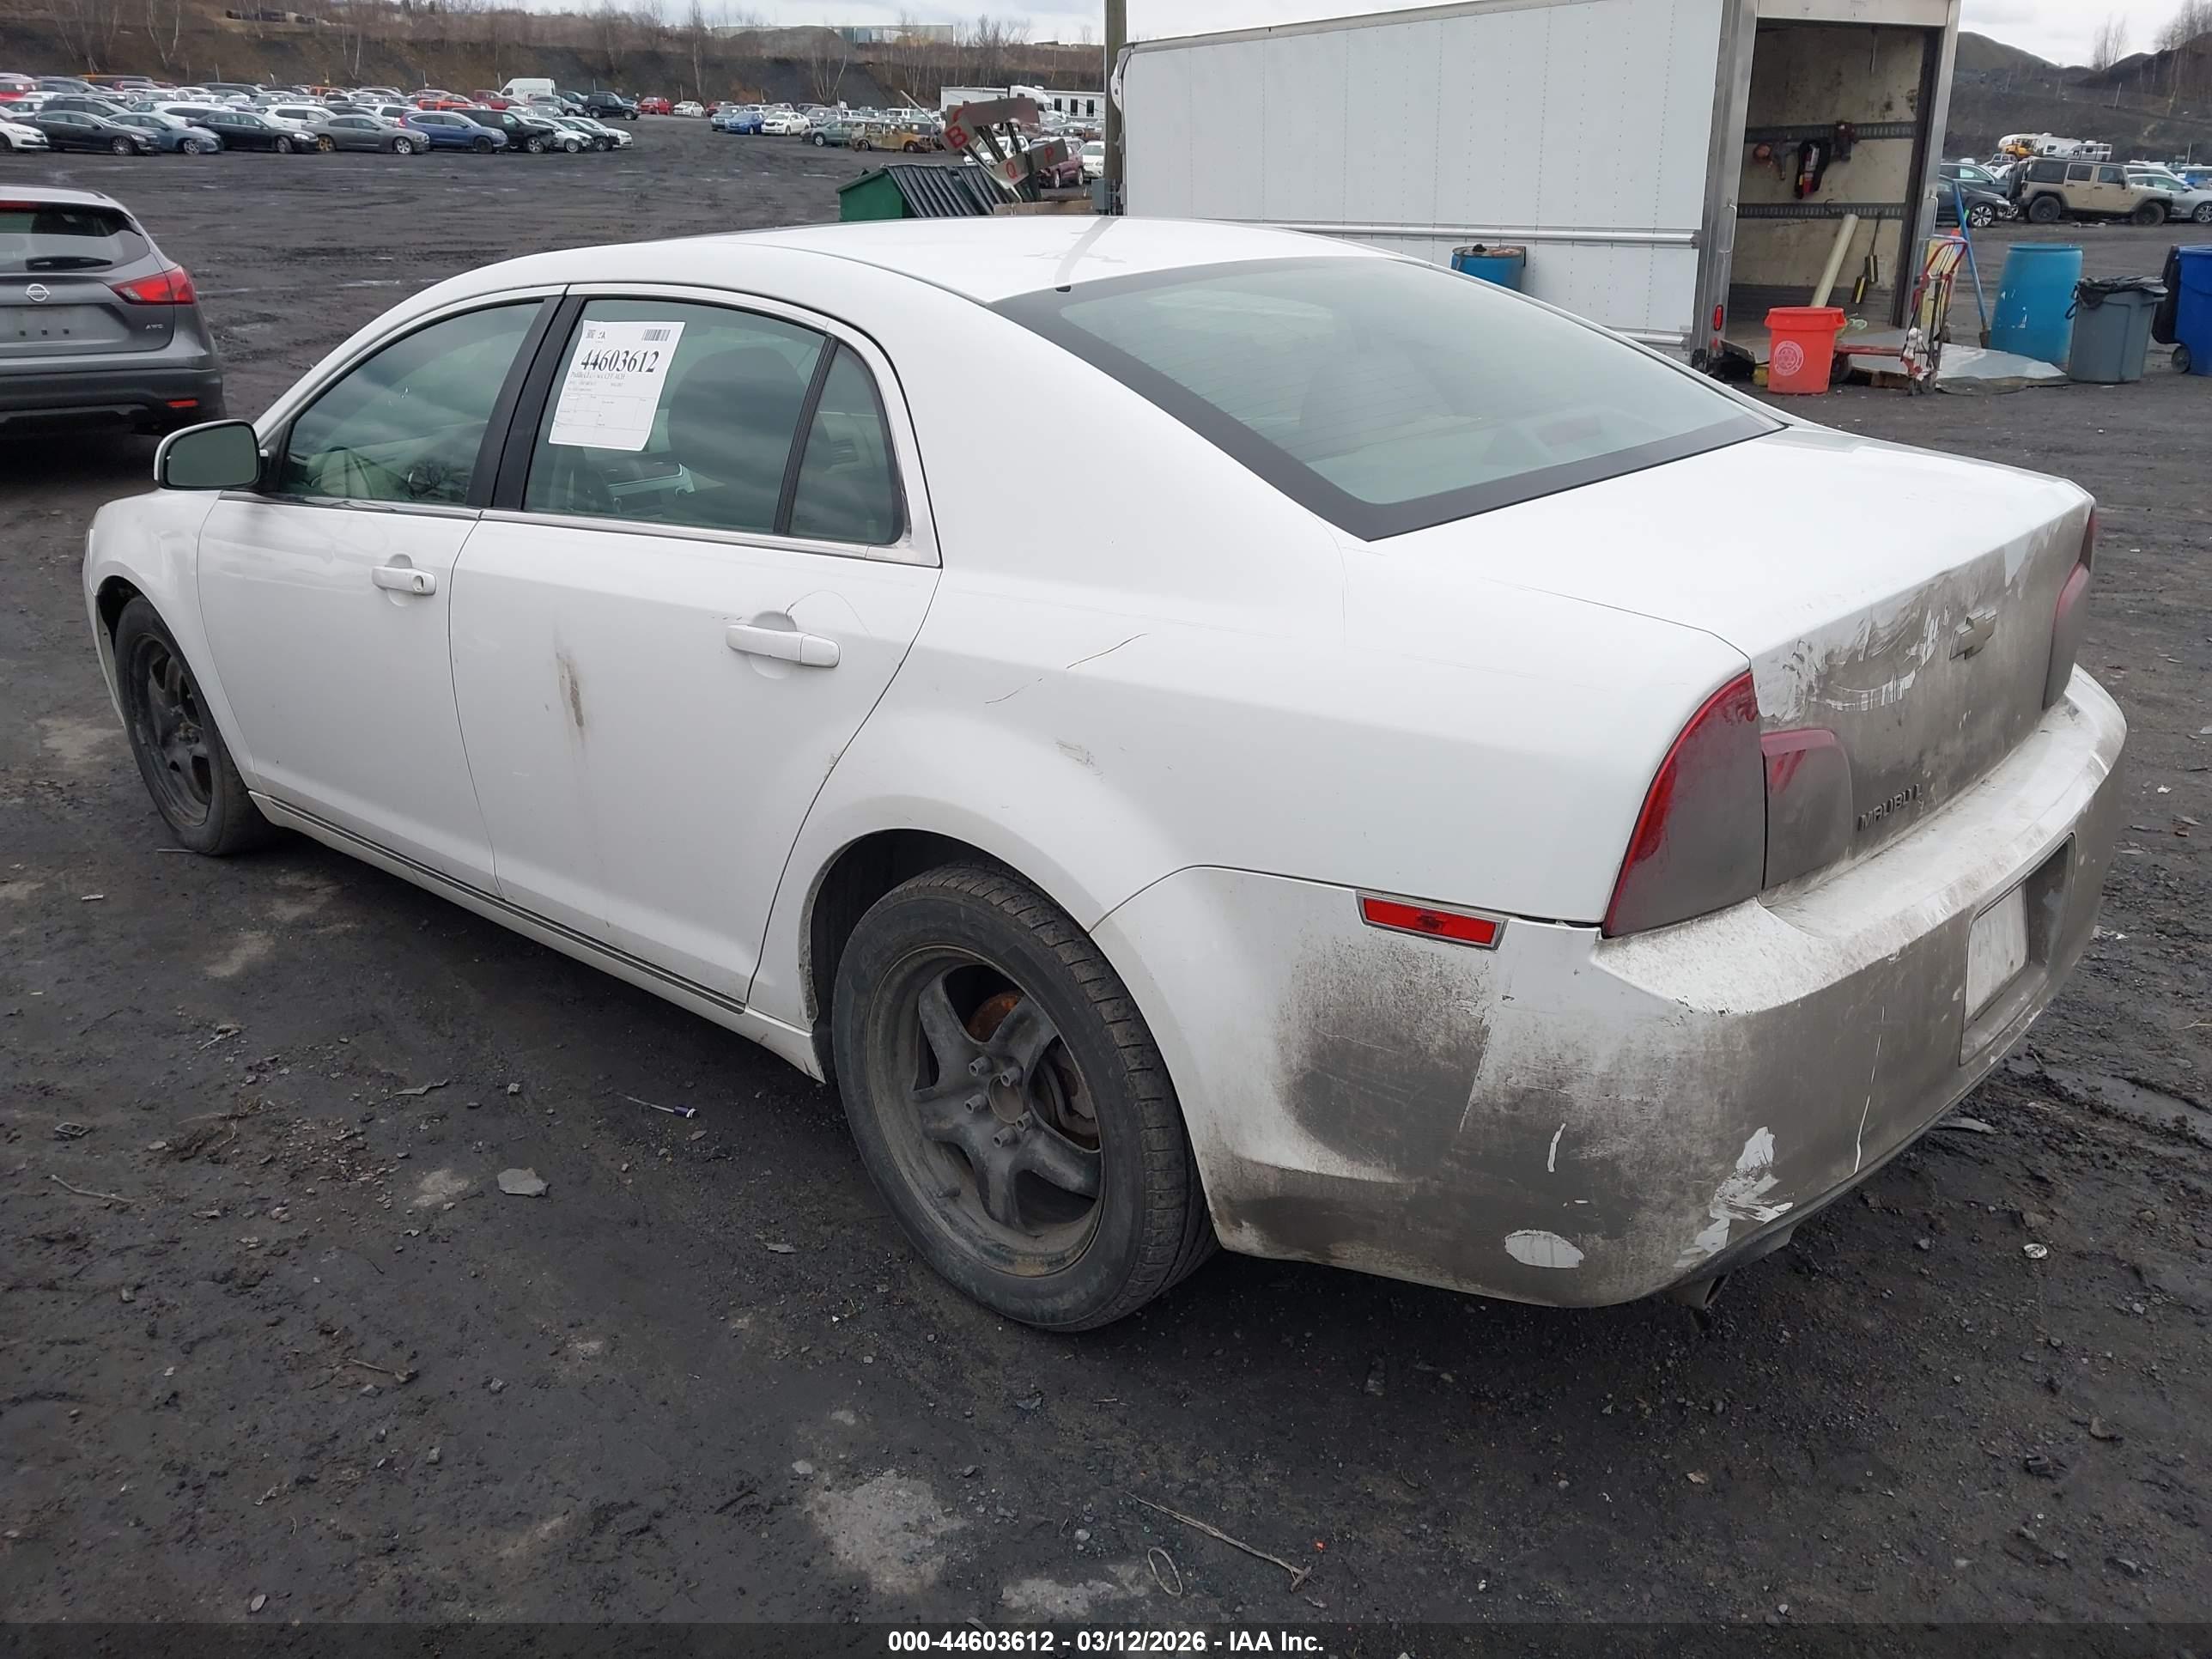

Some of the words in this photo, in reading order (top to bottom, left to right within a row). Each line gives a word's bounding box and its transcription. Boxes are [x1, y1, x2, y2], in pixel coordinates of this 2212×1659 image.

[945, 125, 968, 148] B
[1043, 145, 1054, 164] P
[580, 349, 659, 374] 44603612
